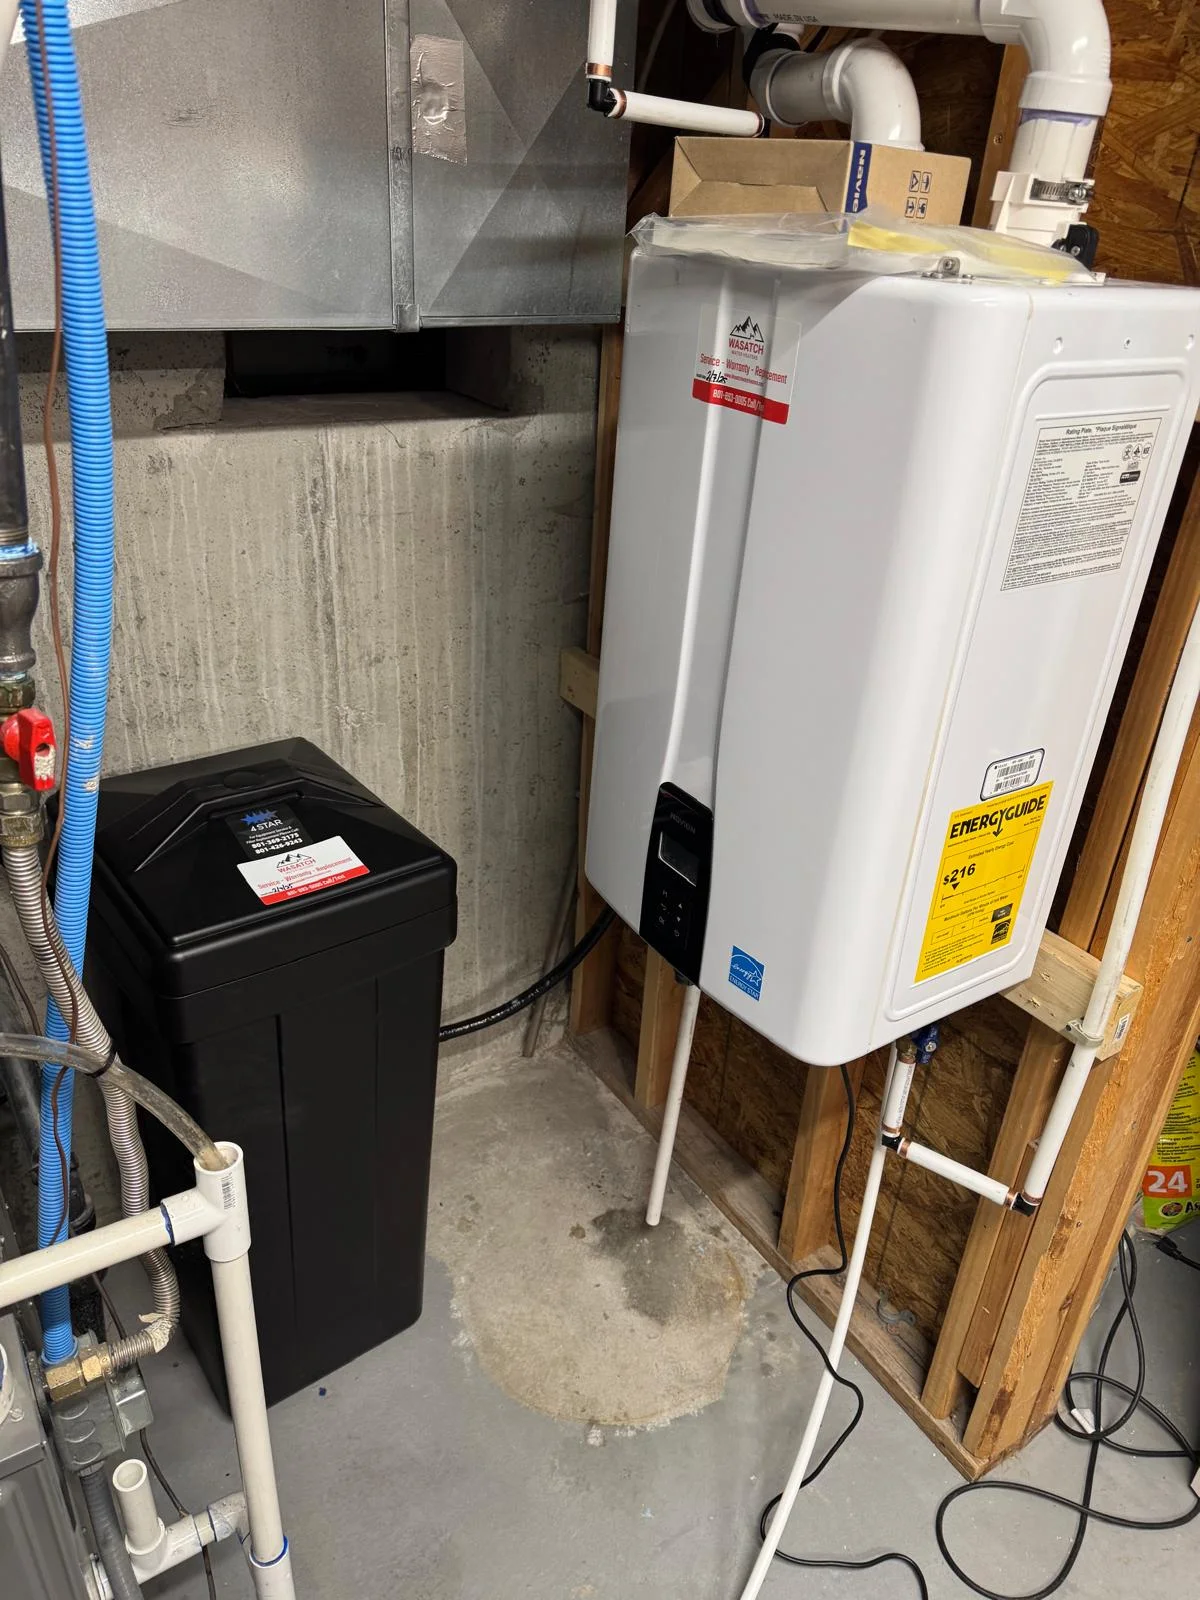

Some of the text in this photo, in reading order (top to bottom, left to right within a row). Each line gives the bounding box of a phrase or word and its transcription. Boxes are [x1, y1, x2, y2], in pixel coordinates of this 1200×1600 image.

[852, 149, 866, 213] NAVIE
[729, 338, 764, 354] WASATCH
[700, 353, 720, 367] Service
[726, 358, 750, 375] Warranty
[949, 794, 1047, 839] ENERGYGUIDE
[278, 858, 316, 873] WASATCH
[943, 863, 976, 885] $216
[1147, 1170, 1188, 1193] 24
